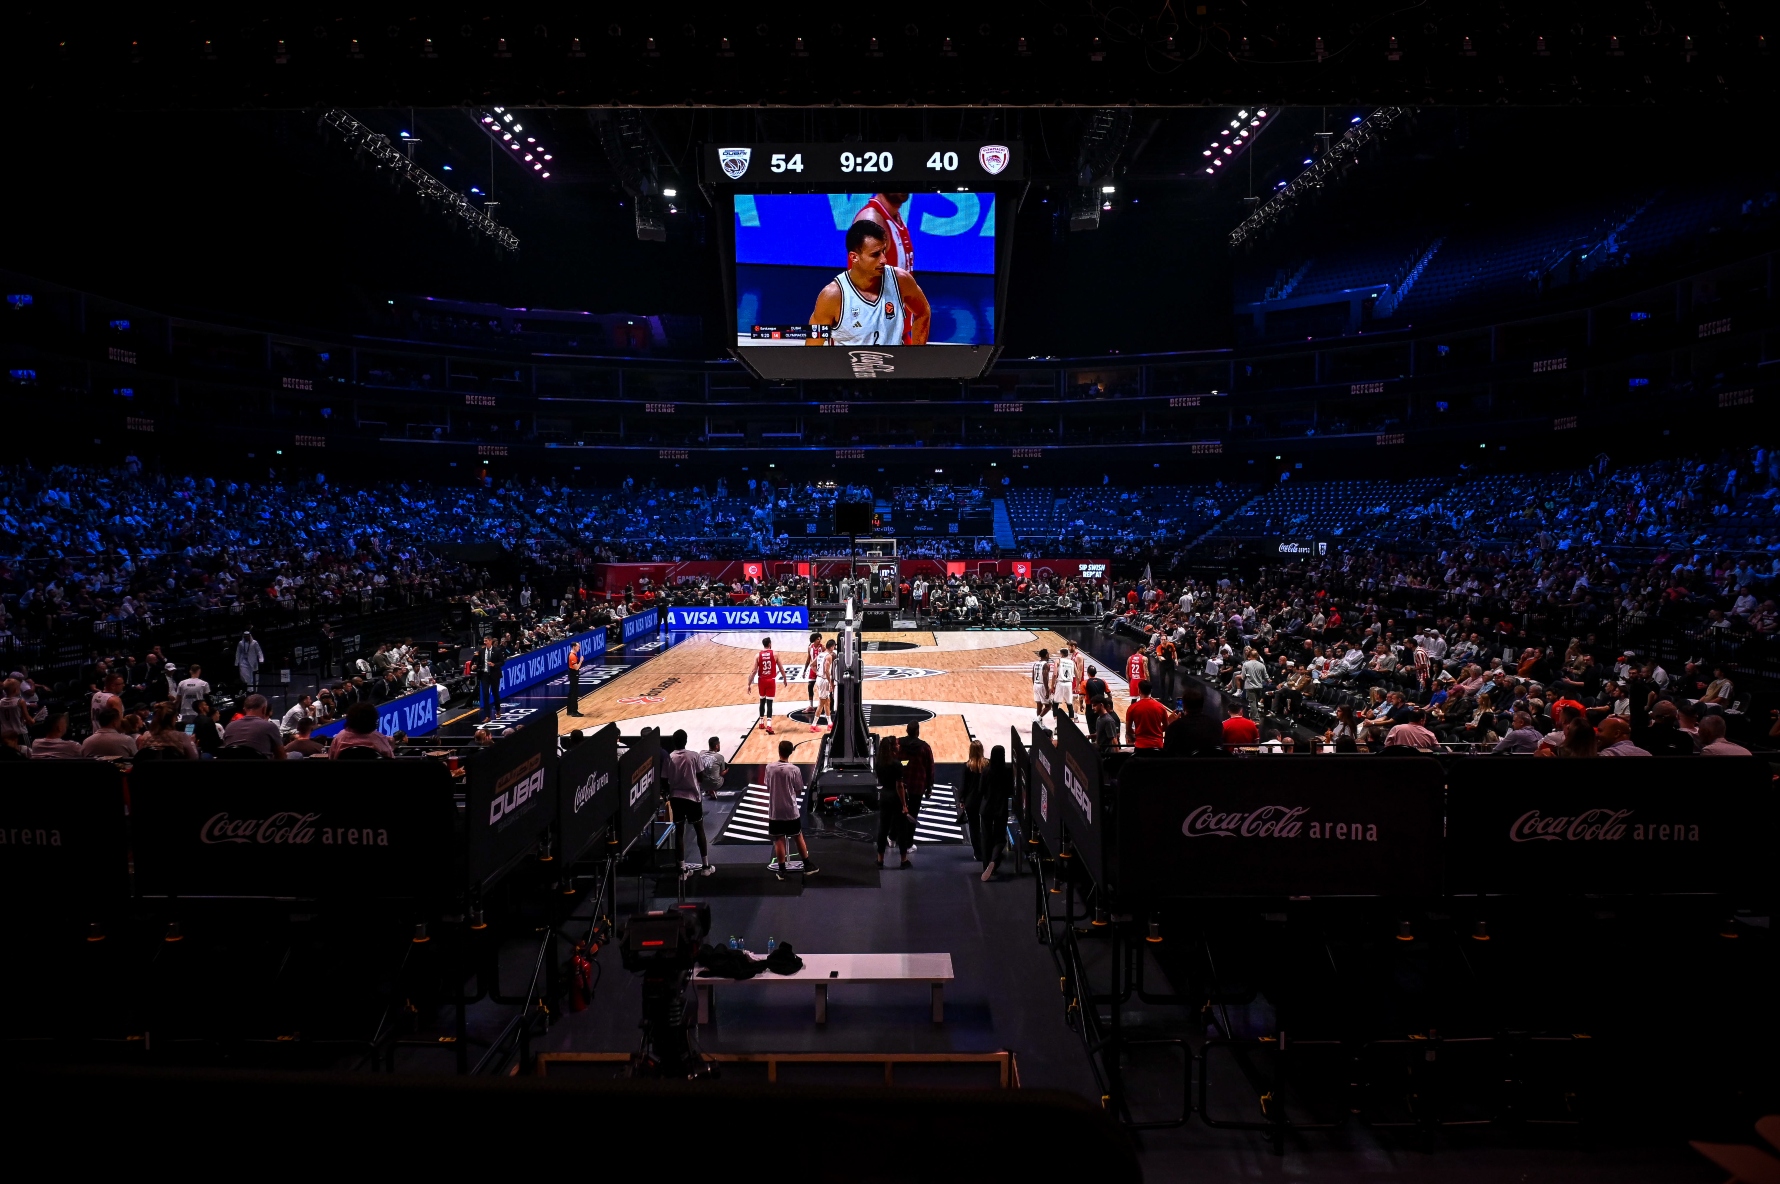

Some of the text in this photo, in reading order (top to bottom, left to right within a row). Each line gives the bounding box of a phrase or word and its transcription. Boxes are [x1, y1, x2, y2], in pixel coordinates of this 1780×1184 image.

[770, 154, 804, 173] 54
[840, 152, 893, 172] 9:20
[926, 152, 959, 171] 40
[1698, 317, 1731, 338] DEFENSE
[873, 331, 880, 345] 2
[1533, 358, 1567, 373] DEFENSE
[282, 377, 313, 391] DEFENSE
[1351, 383, 1384, 395] DEFENSE
[465, 395, 496, 406] DEFENSE
[993, 403, 1023, 412] DEFENSE
[1169, 397, 1200, 407] DEFENSE
[645, 403, 675, 413] DEFENSE
[819, 404, 849, 414] DEFENSE
[295, 435, 325, 447] DEFENSE
[1376, 433, 1404, 445] DEFENSE
[478, 445, 508, 456] DEFENSE
[659, 450, 689, 459] DEFENSE
[835, 449, 865, 459] DEFENSE
[1012, 449, 1042, 458] DEFENSE
[1191, 444, 1223, 454] DEFENSE
[1278, 542, 1299, 553] Coca-Cola
[680, 611, 718, 625] VISA
[722, 611, 760, 625] VISA
[764, 610, 802, 624] VISA
[624, 621, 635, 637] VISA
[635, 617, 644, 633] VISA
[507, 662, 526, 687] VISA
[528, 655, 545, 679] VISA
[546, 648, 562, 671] VISA
[592, 633, 605, 652] VISA
[762, 660, 772, 671] 33
[1131, 664, 1140, 674] 22
[378, 698, 433, 738] ISA VISA
[574, 770, 597, 814] Coca-Cola
[597, 772, 609, 791] arena
[630, 766, 655, 808] DUBAI
[489, 767, 545, 826] DUBAI
[1064, 764, 1092, 825] DUBAI
[200, 811, 389, 847] Coca-Cola arena
[1182, 805, 1378, 842] Coca-Cola arena
[1510, 808, 1700, 843] Coca-Cola arena
[0, 827, 62, 847] arena
